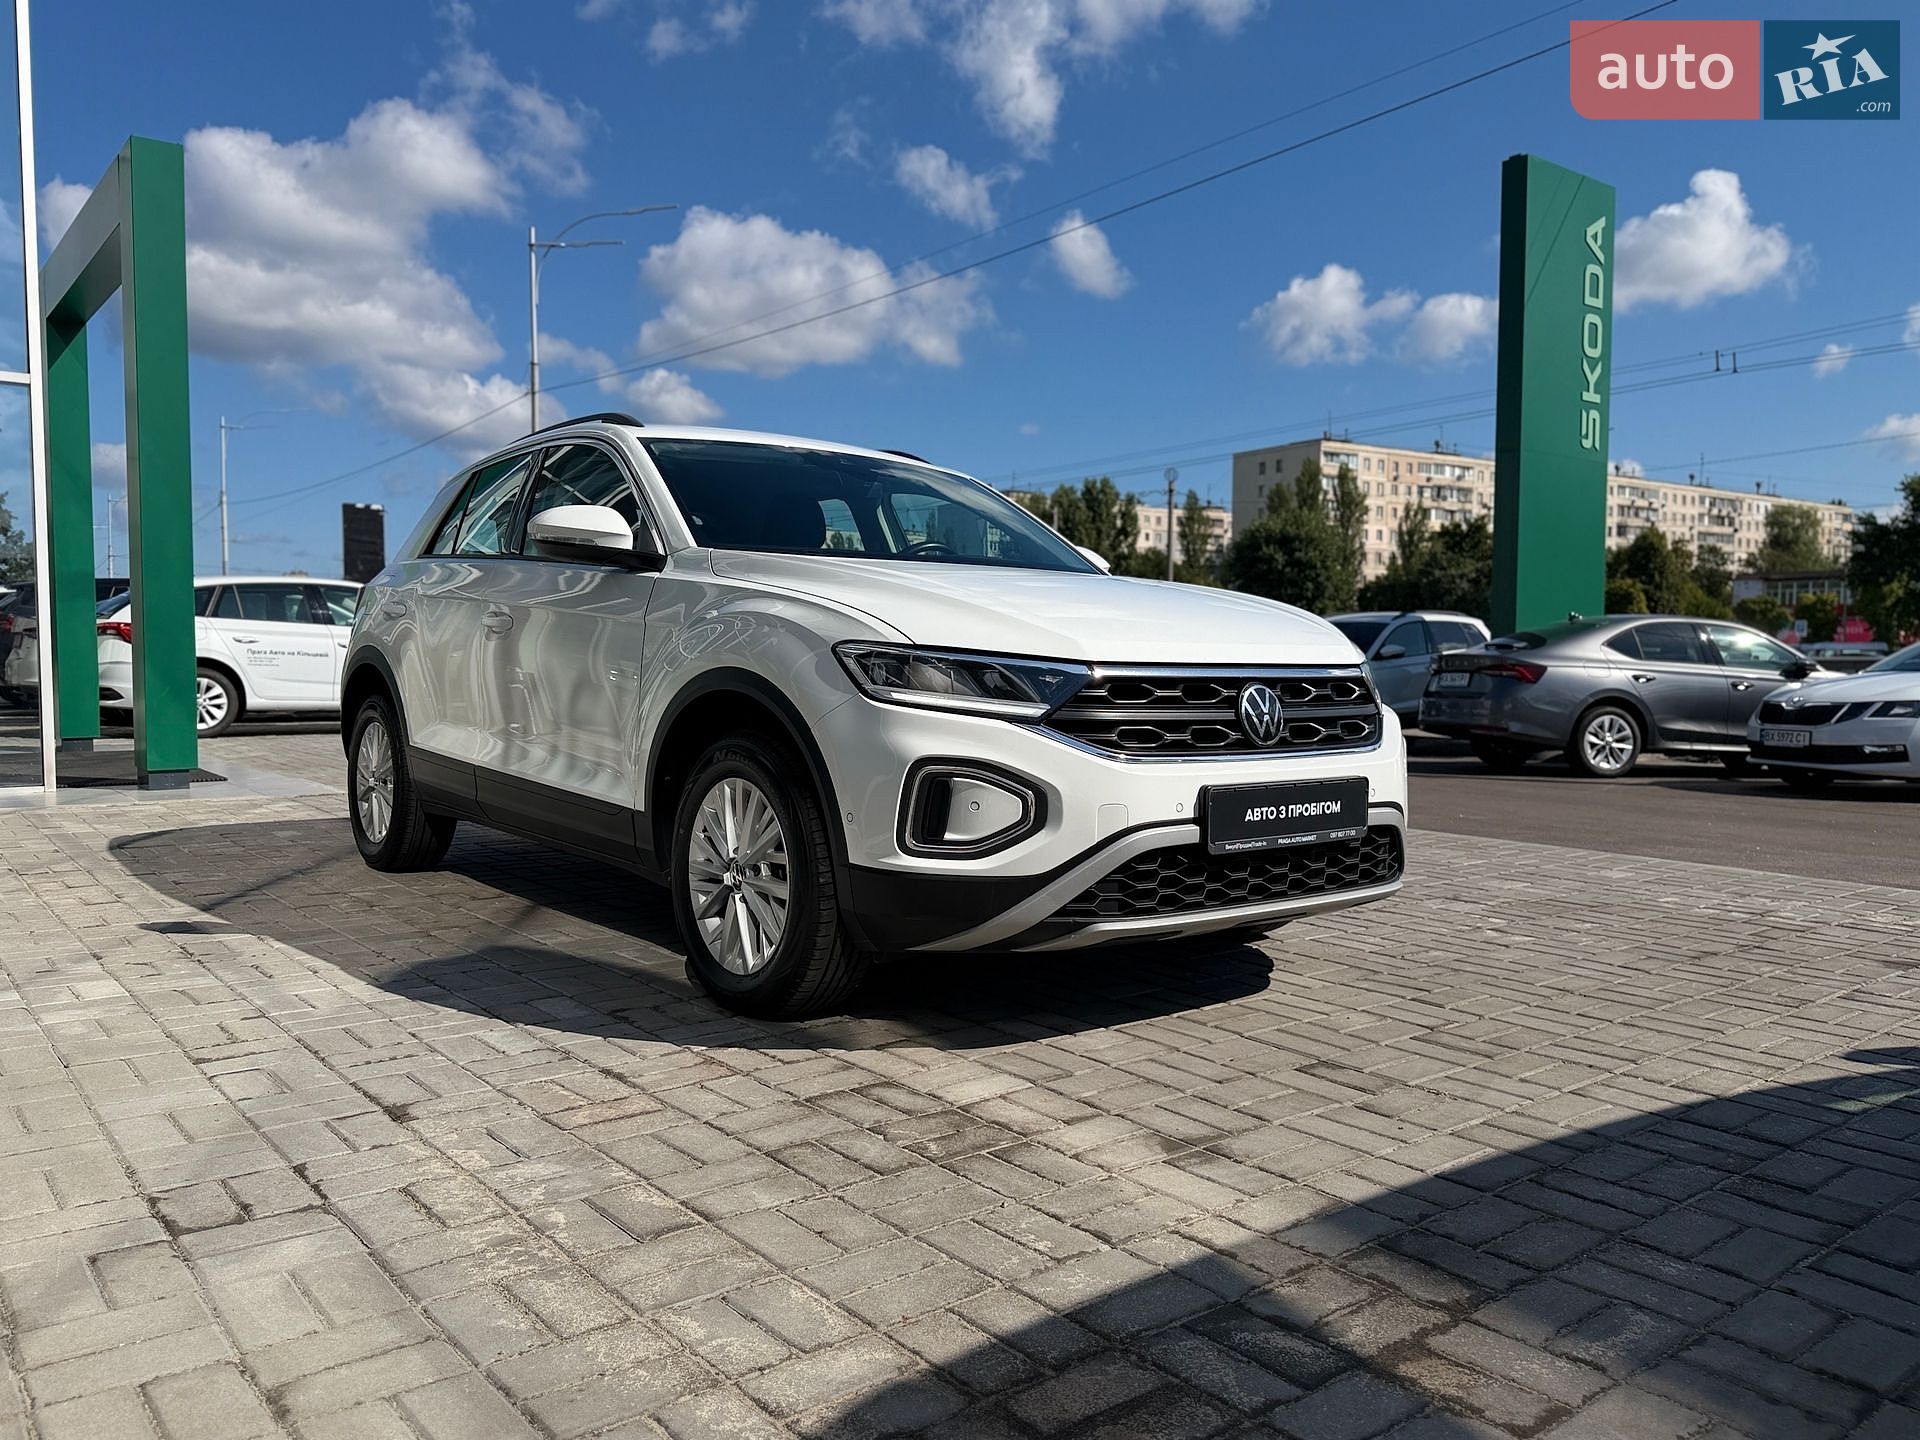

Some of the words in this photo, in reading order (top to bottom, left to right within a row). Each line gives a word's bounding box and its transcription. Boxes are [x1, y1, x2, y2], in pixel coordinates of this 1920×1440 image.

[246, 648, 267, 656] Прага
[1777, 732, 1794, 743] 5972
[1245, 806, 1277, 822] АВТО
[1278, 805, 1287, 819] З
[1288, 801, 1341, 817] ПРОБІГОМ
